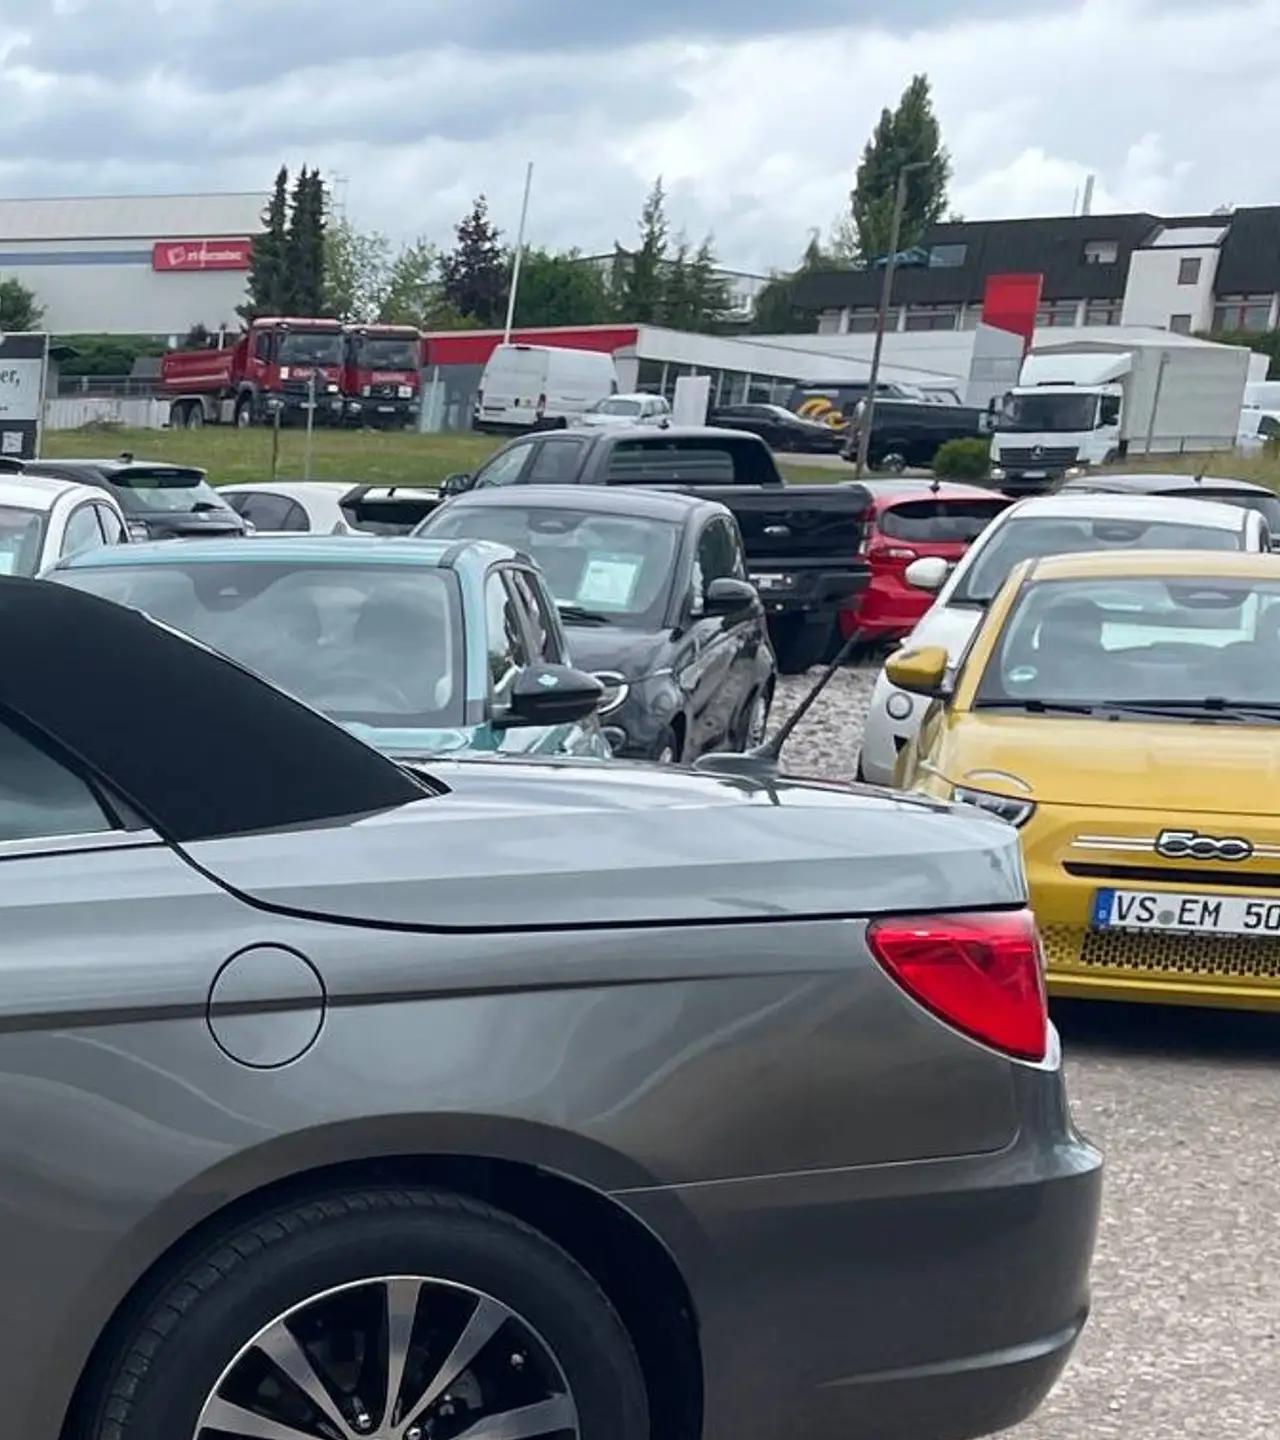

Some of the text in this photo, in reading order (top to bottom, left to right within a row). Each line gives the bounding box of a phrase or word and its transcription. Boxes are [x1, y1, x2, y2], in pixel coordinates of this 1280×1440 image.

[1157, 830, 1252, 860] 500
[1116, 894, 1280, 931] VS EM 50
